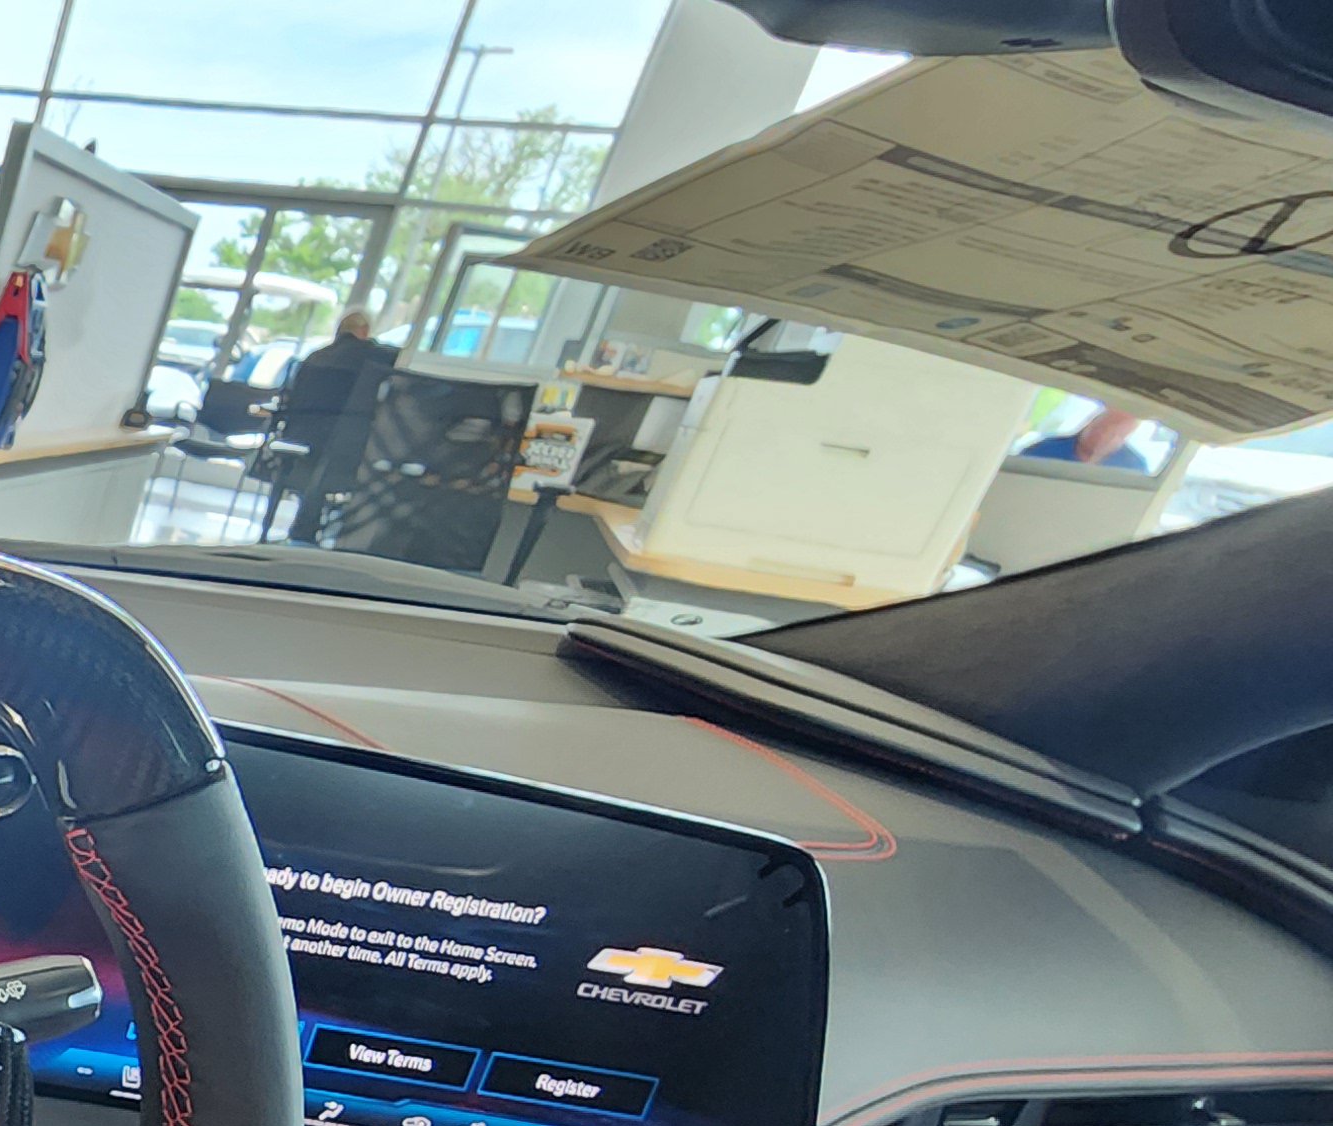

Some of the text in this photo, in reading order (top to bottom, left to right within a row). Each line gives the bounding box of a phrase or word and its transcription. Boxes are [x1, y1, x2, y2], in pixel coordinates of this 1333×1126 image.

[264, 866, 546, 924] ady to begin Owner Registration?
[306, 918, 349, 940] Mode
[350, 925, 365, 942] to
[367, 928, 395, 946] exit
[397, 932, 413, 950] to
[414, 935, 439, 954] the
[441, 939, 483, 960] Home
[290, 938, 348, 959] another
[348, 944, 383, 965] time.
[384, 950, 404, 967] All
[407, 954, 450, 975] Terms
[450, 961, 492, 983] apply.
[577, 983, 708, 1015] CHEVROLET
[349, 1043, 433, 1072] View Terms
[535, 1073, 602, 1098] Register
